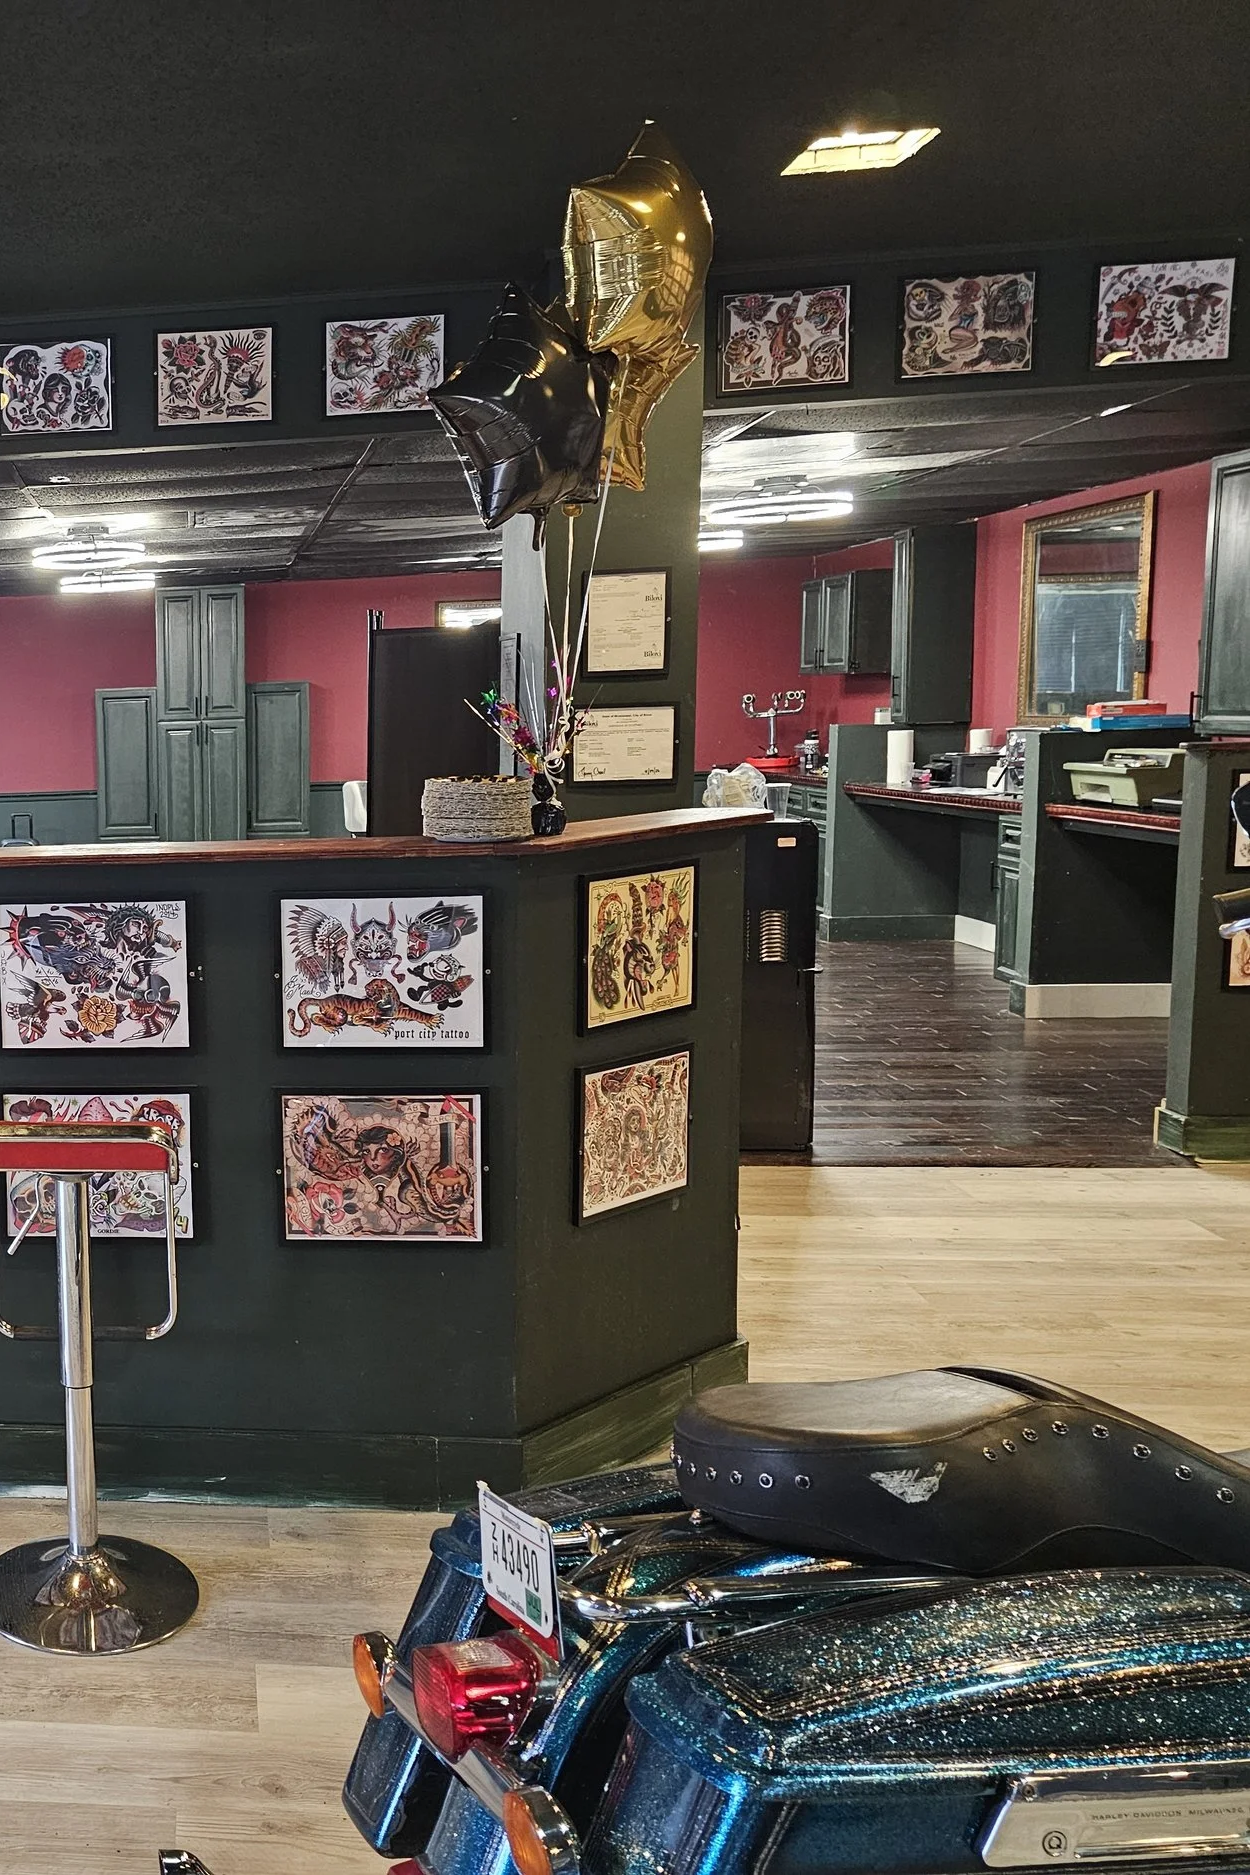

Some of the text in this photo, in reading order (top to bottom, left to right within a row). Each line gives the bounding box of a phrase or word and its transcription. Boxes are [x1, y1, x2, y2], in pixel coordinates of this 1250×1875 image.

[394, 1028, 470, 1041] port city tattoo
[501, 1529, 540, 1593] 43490
[1091, 1813, 1129, 1821] HARLEY
[1132, 1809, 1182, 1818] DAVIDSON
